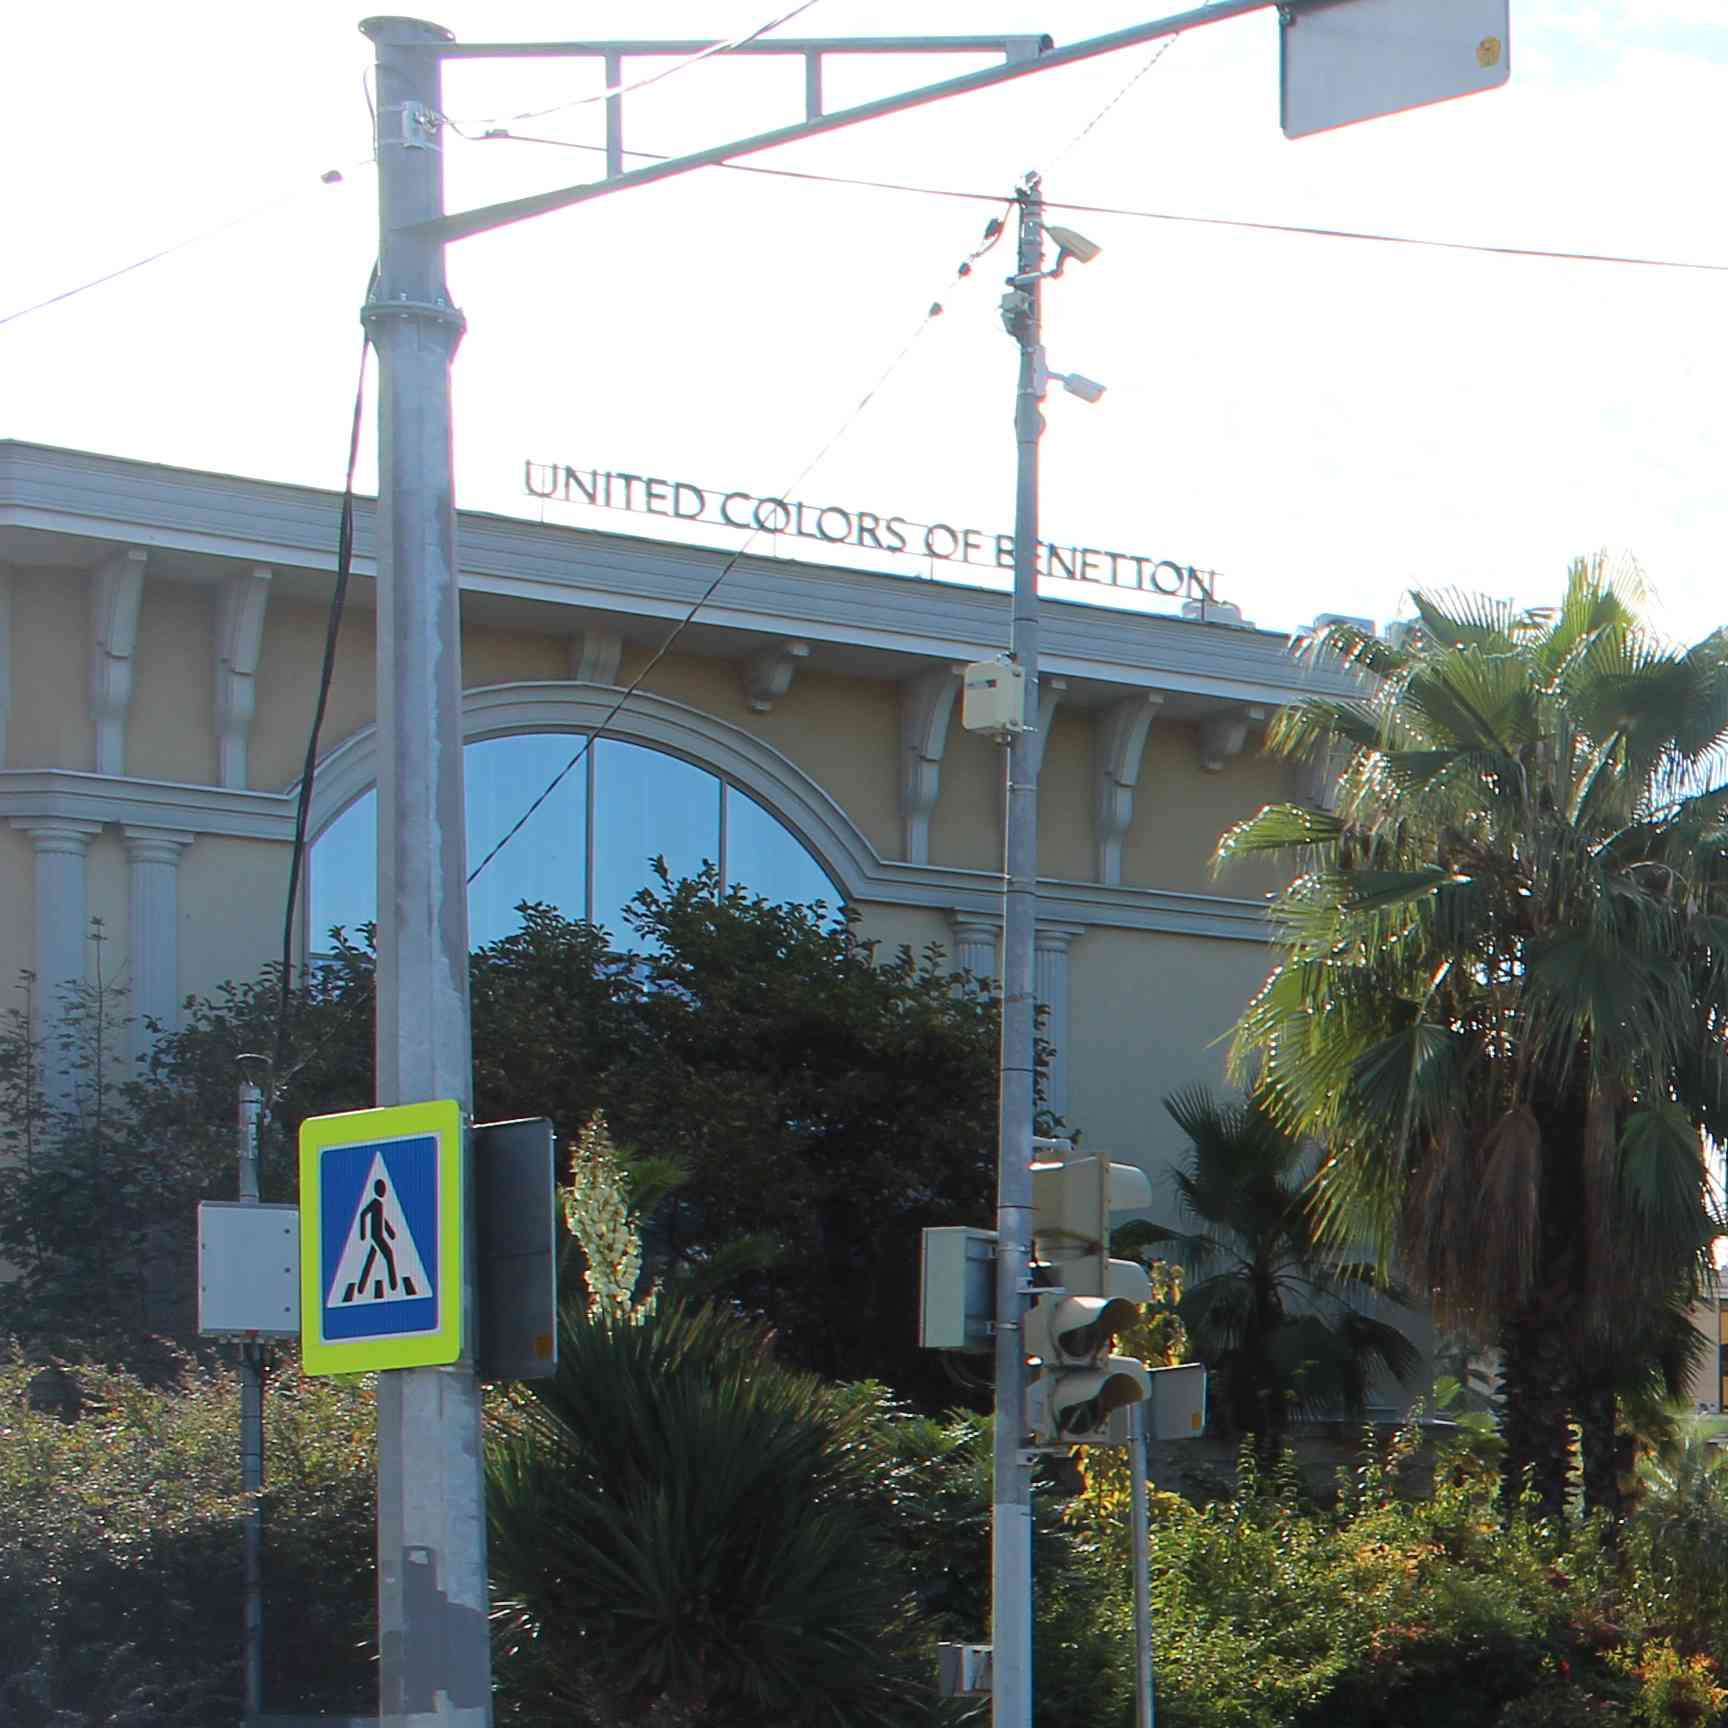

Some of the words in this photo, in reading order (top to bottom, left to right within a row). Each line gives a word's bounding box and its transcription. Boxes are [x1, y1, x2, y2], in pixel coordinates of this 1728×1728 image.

[525, 459, 705, 520] UNITED
[721, 492, 907, 553] COLORS
[924, 523, 982, 562] OF
